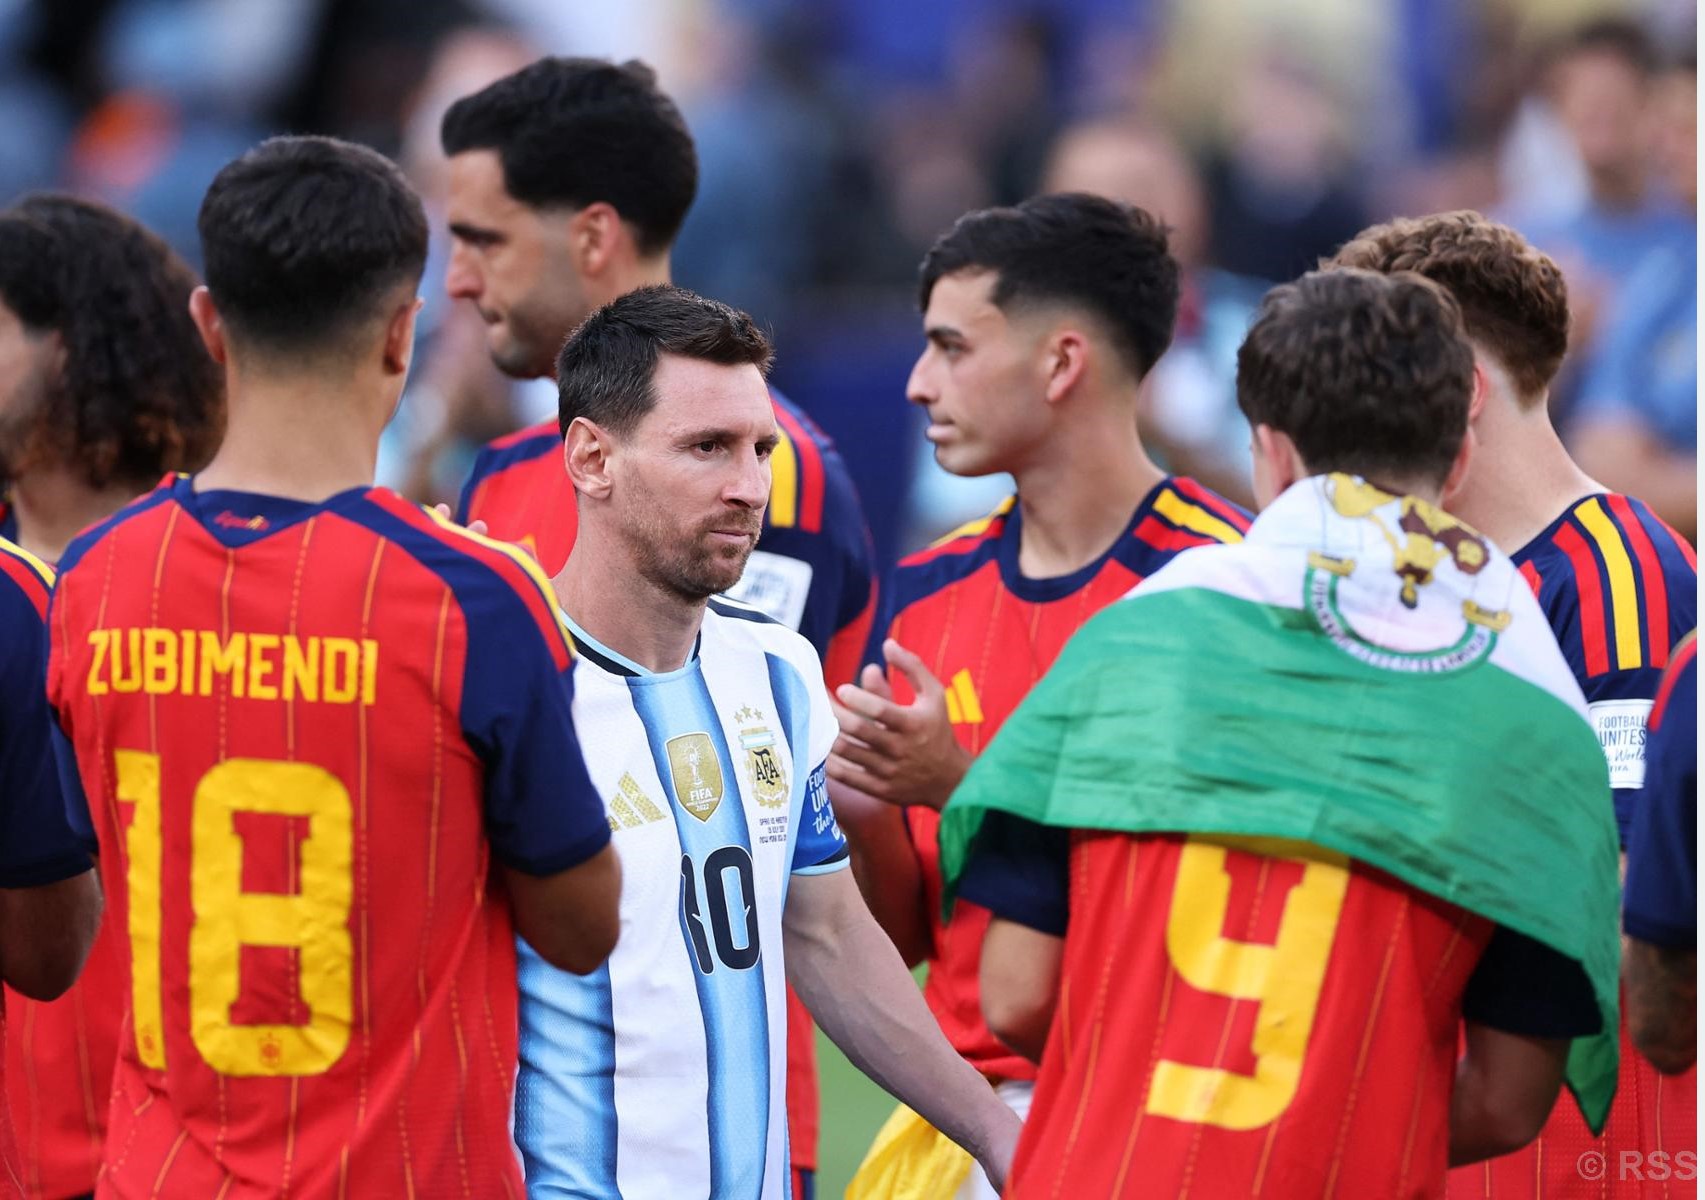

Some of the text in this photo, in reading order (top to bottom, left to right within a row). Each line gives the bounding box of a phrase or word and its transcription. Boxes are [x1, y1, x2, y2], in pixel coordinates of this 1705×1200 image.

[87, 628, 377, 705] ZUBIMENDI
[1599, 715, 1647, 728] FOOTBALL
[1600, 729, 1646, 747] UNITES
[690, 787, 713, 801] FIFA
[114, 749, 354, 1077] 18
[679, 845, 761, 975] 10
[1145, 832, 1349, 1130] 9
